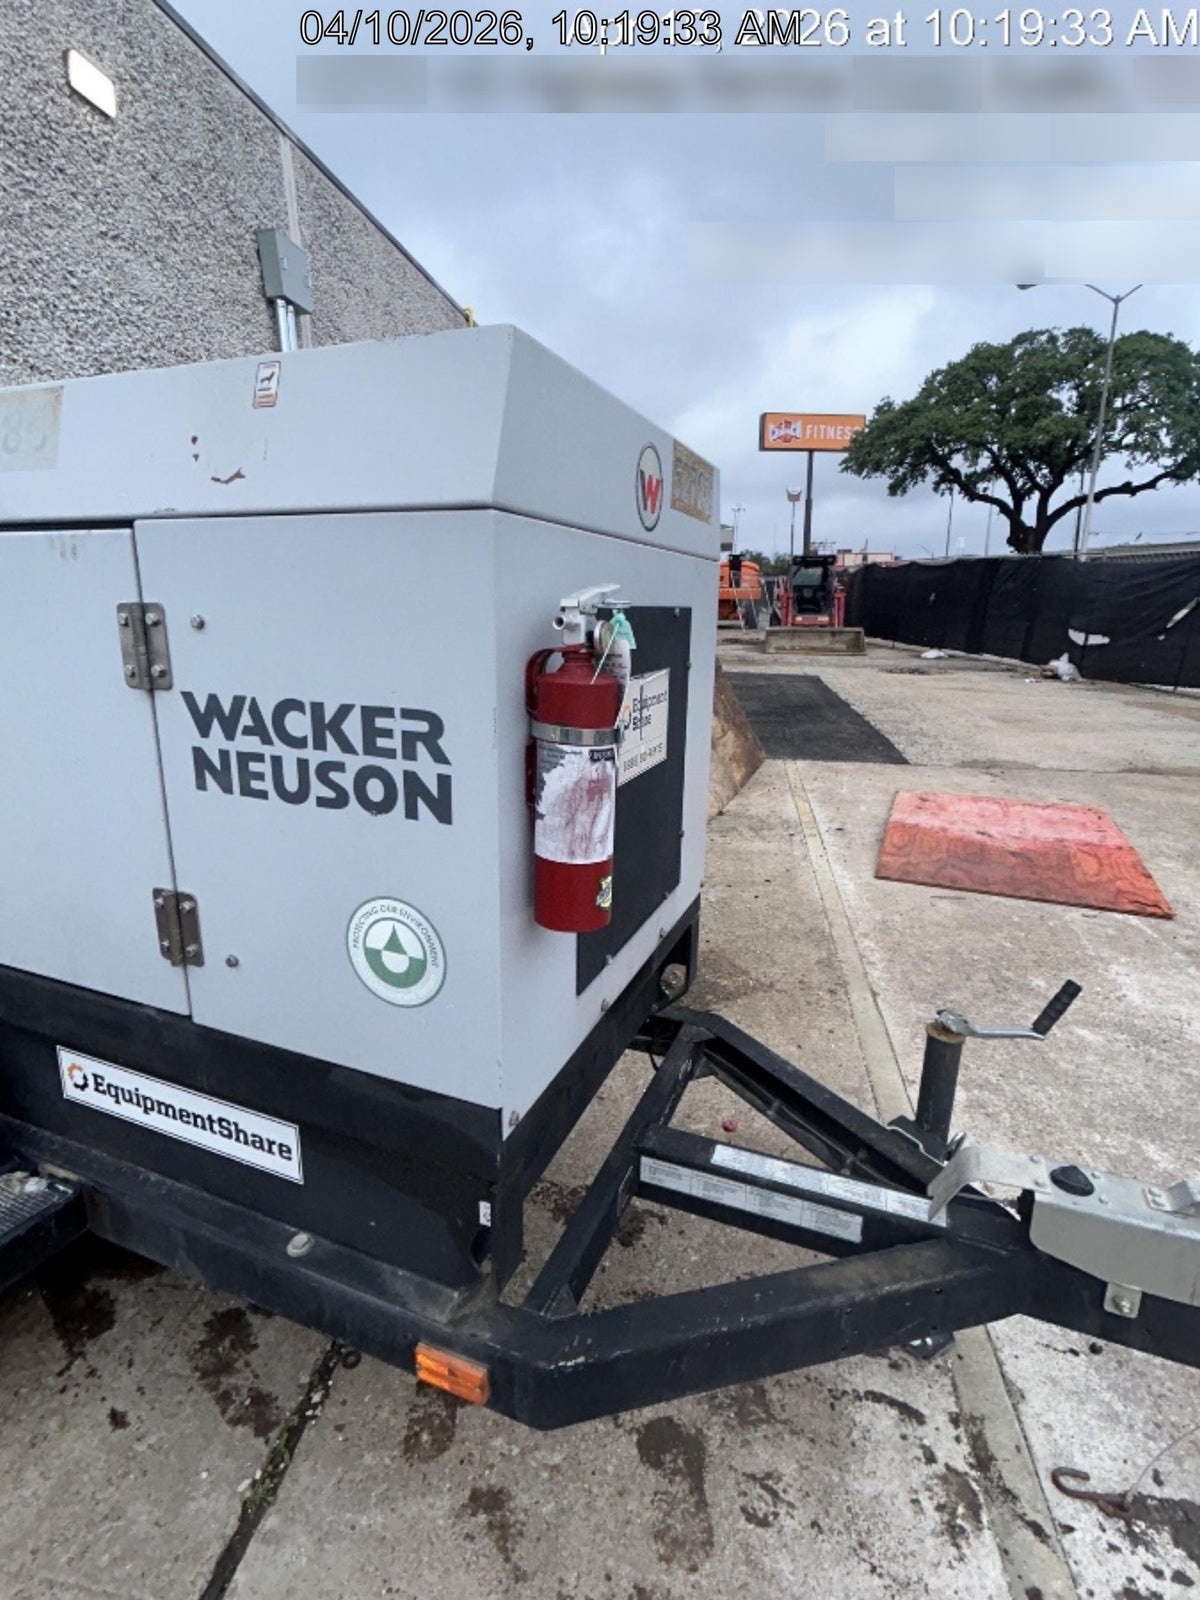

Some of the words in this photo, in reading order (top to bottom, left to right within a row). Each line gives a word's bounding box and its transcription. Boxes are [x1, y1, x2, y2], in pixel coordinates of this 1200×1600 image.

[180, 691, 452, 766] WACKER
[191, 746, 452, 825] NEUSON
[91, 1072, 293, 1161] EquipmentShare
